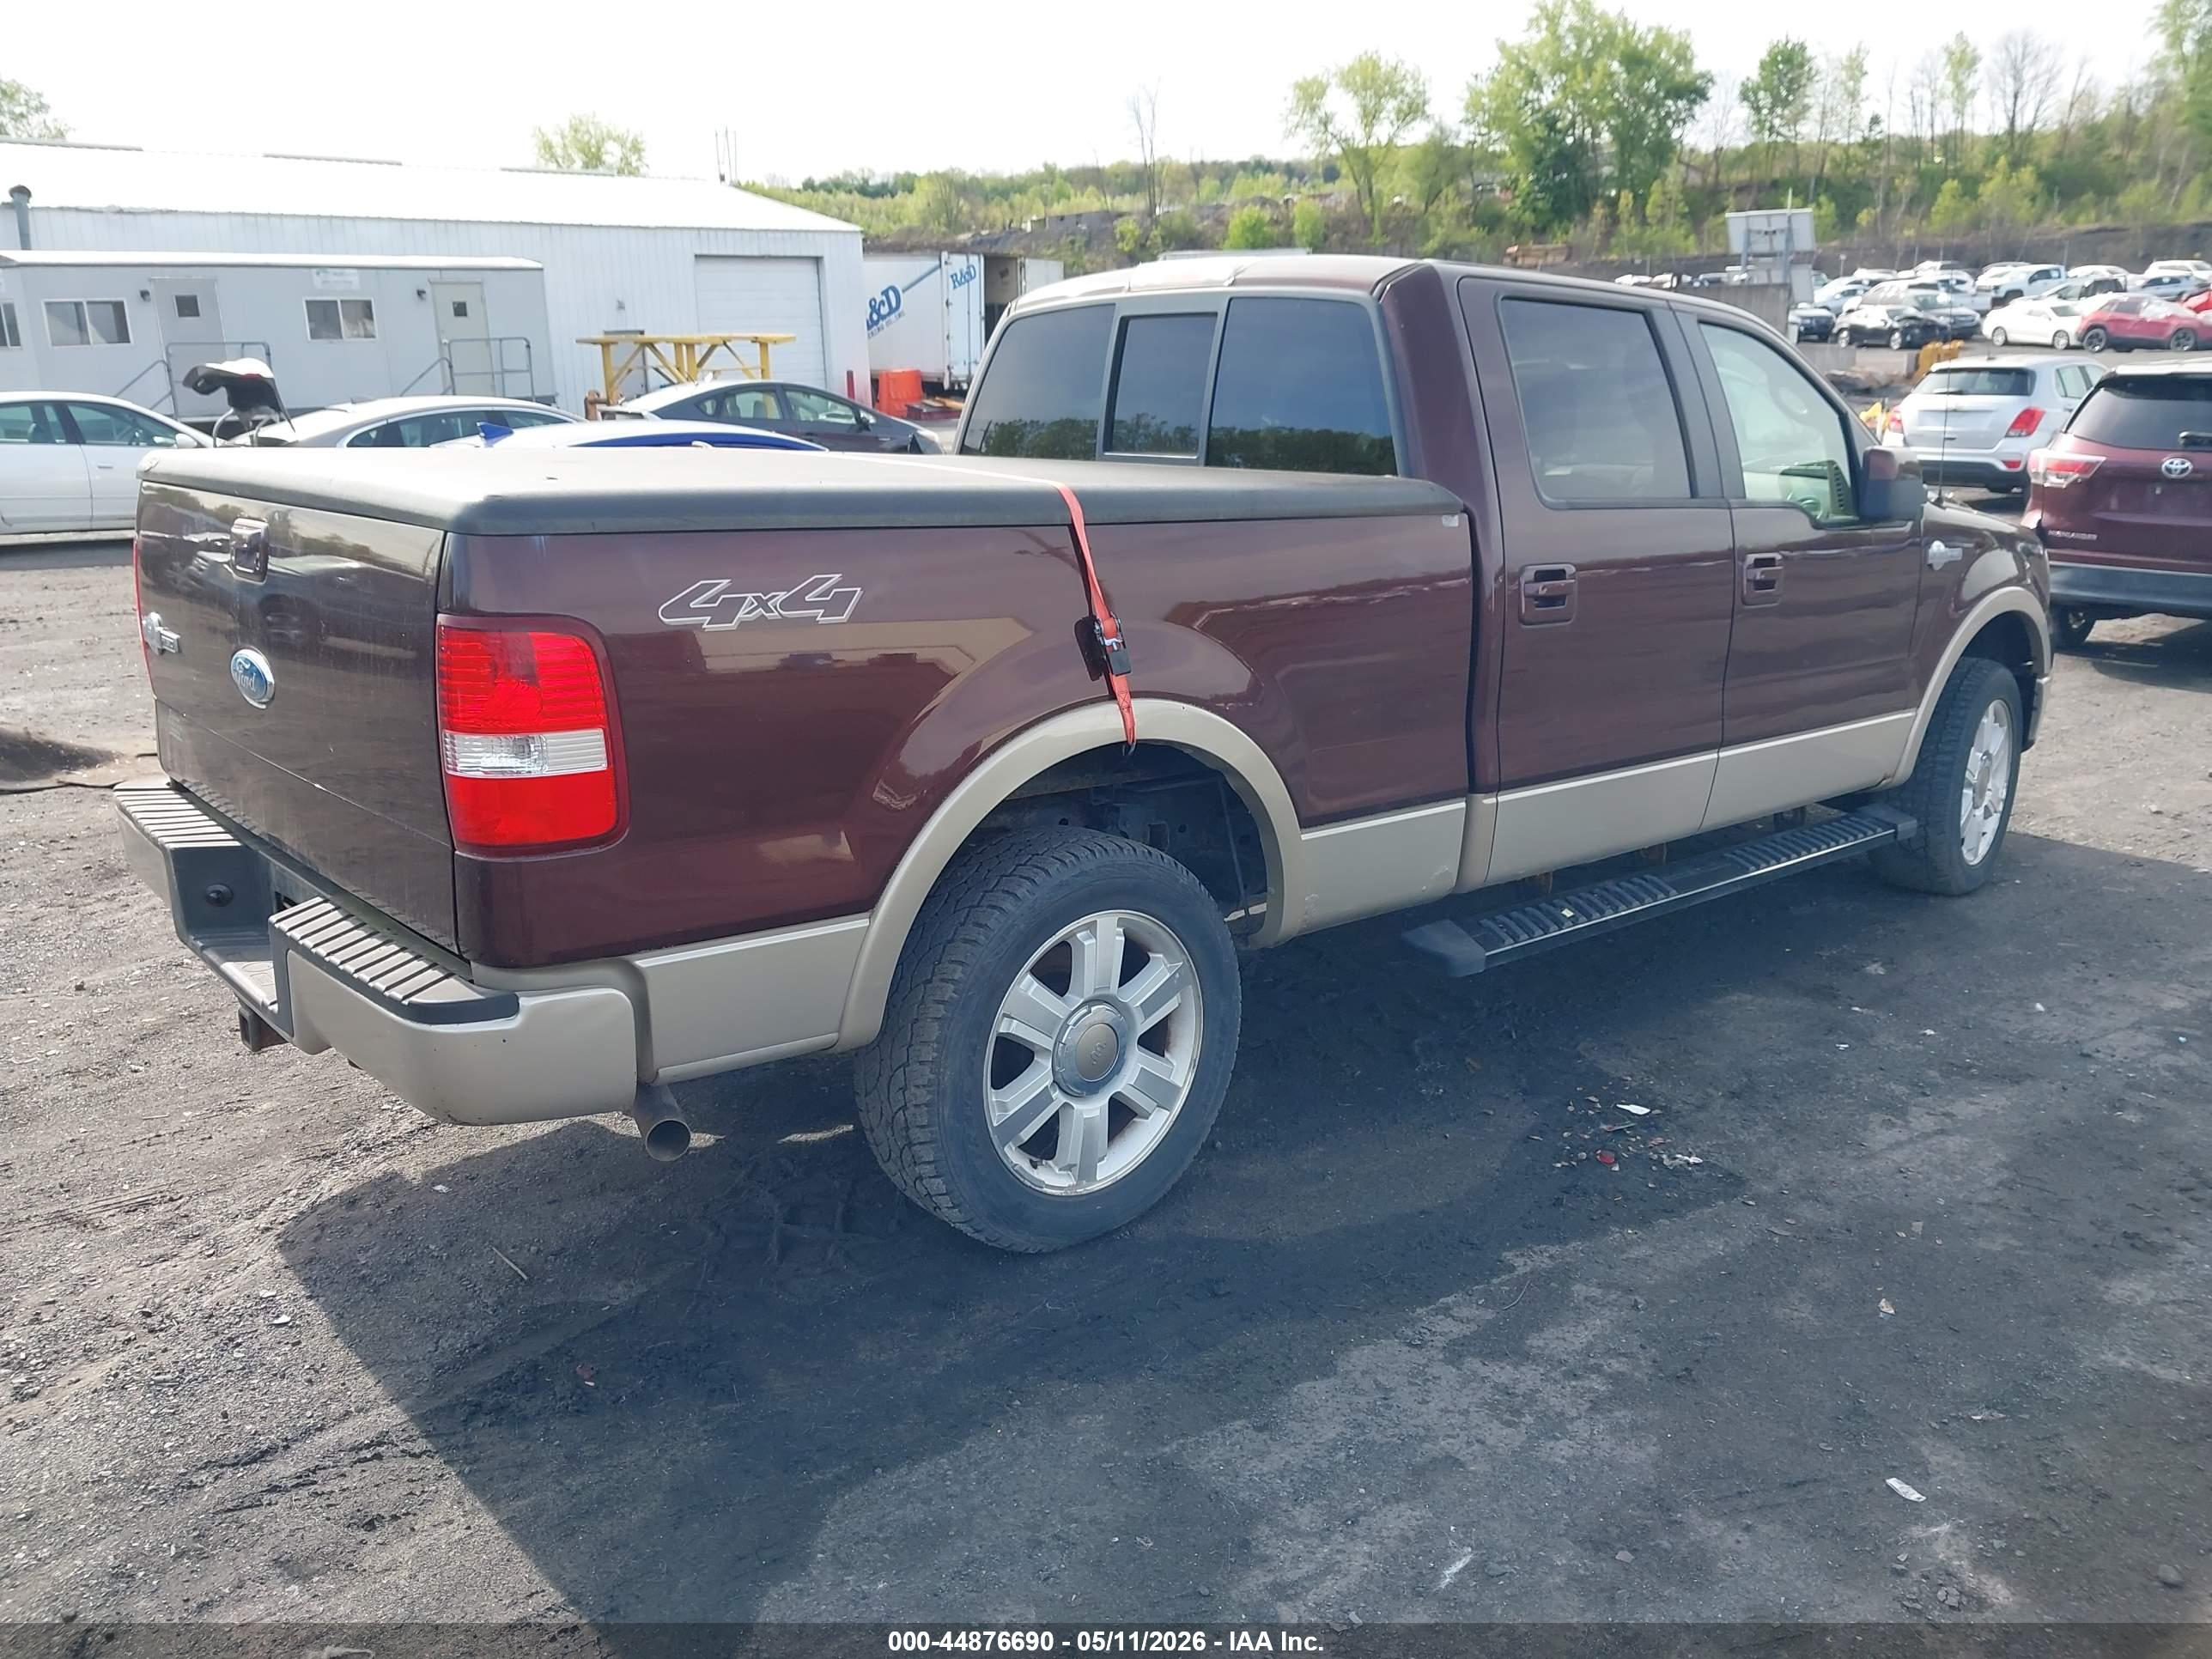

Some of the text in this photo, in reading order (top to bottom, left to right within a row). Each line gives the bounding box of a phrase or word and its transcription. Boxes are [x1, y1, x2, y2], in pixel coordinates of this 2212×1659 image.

[950, 264, 976, 289] R&D
[866, 285, 901, 331] &D
[658, 574, 864, 631] 4x4
